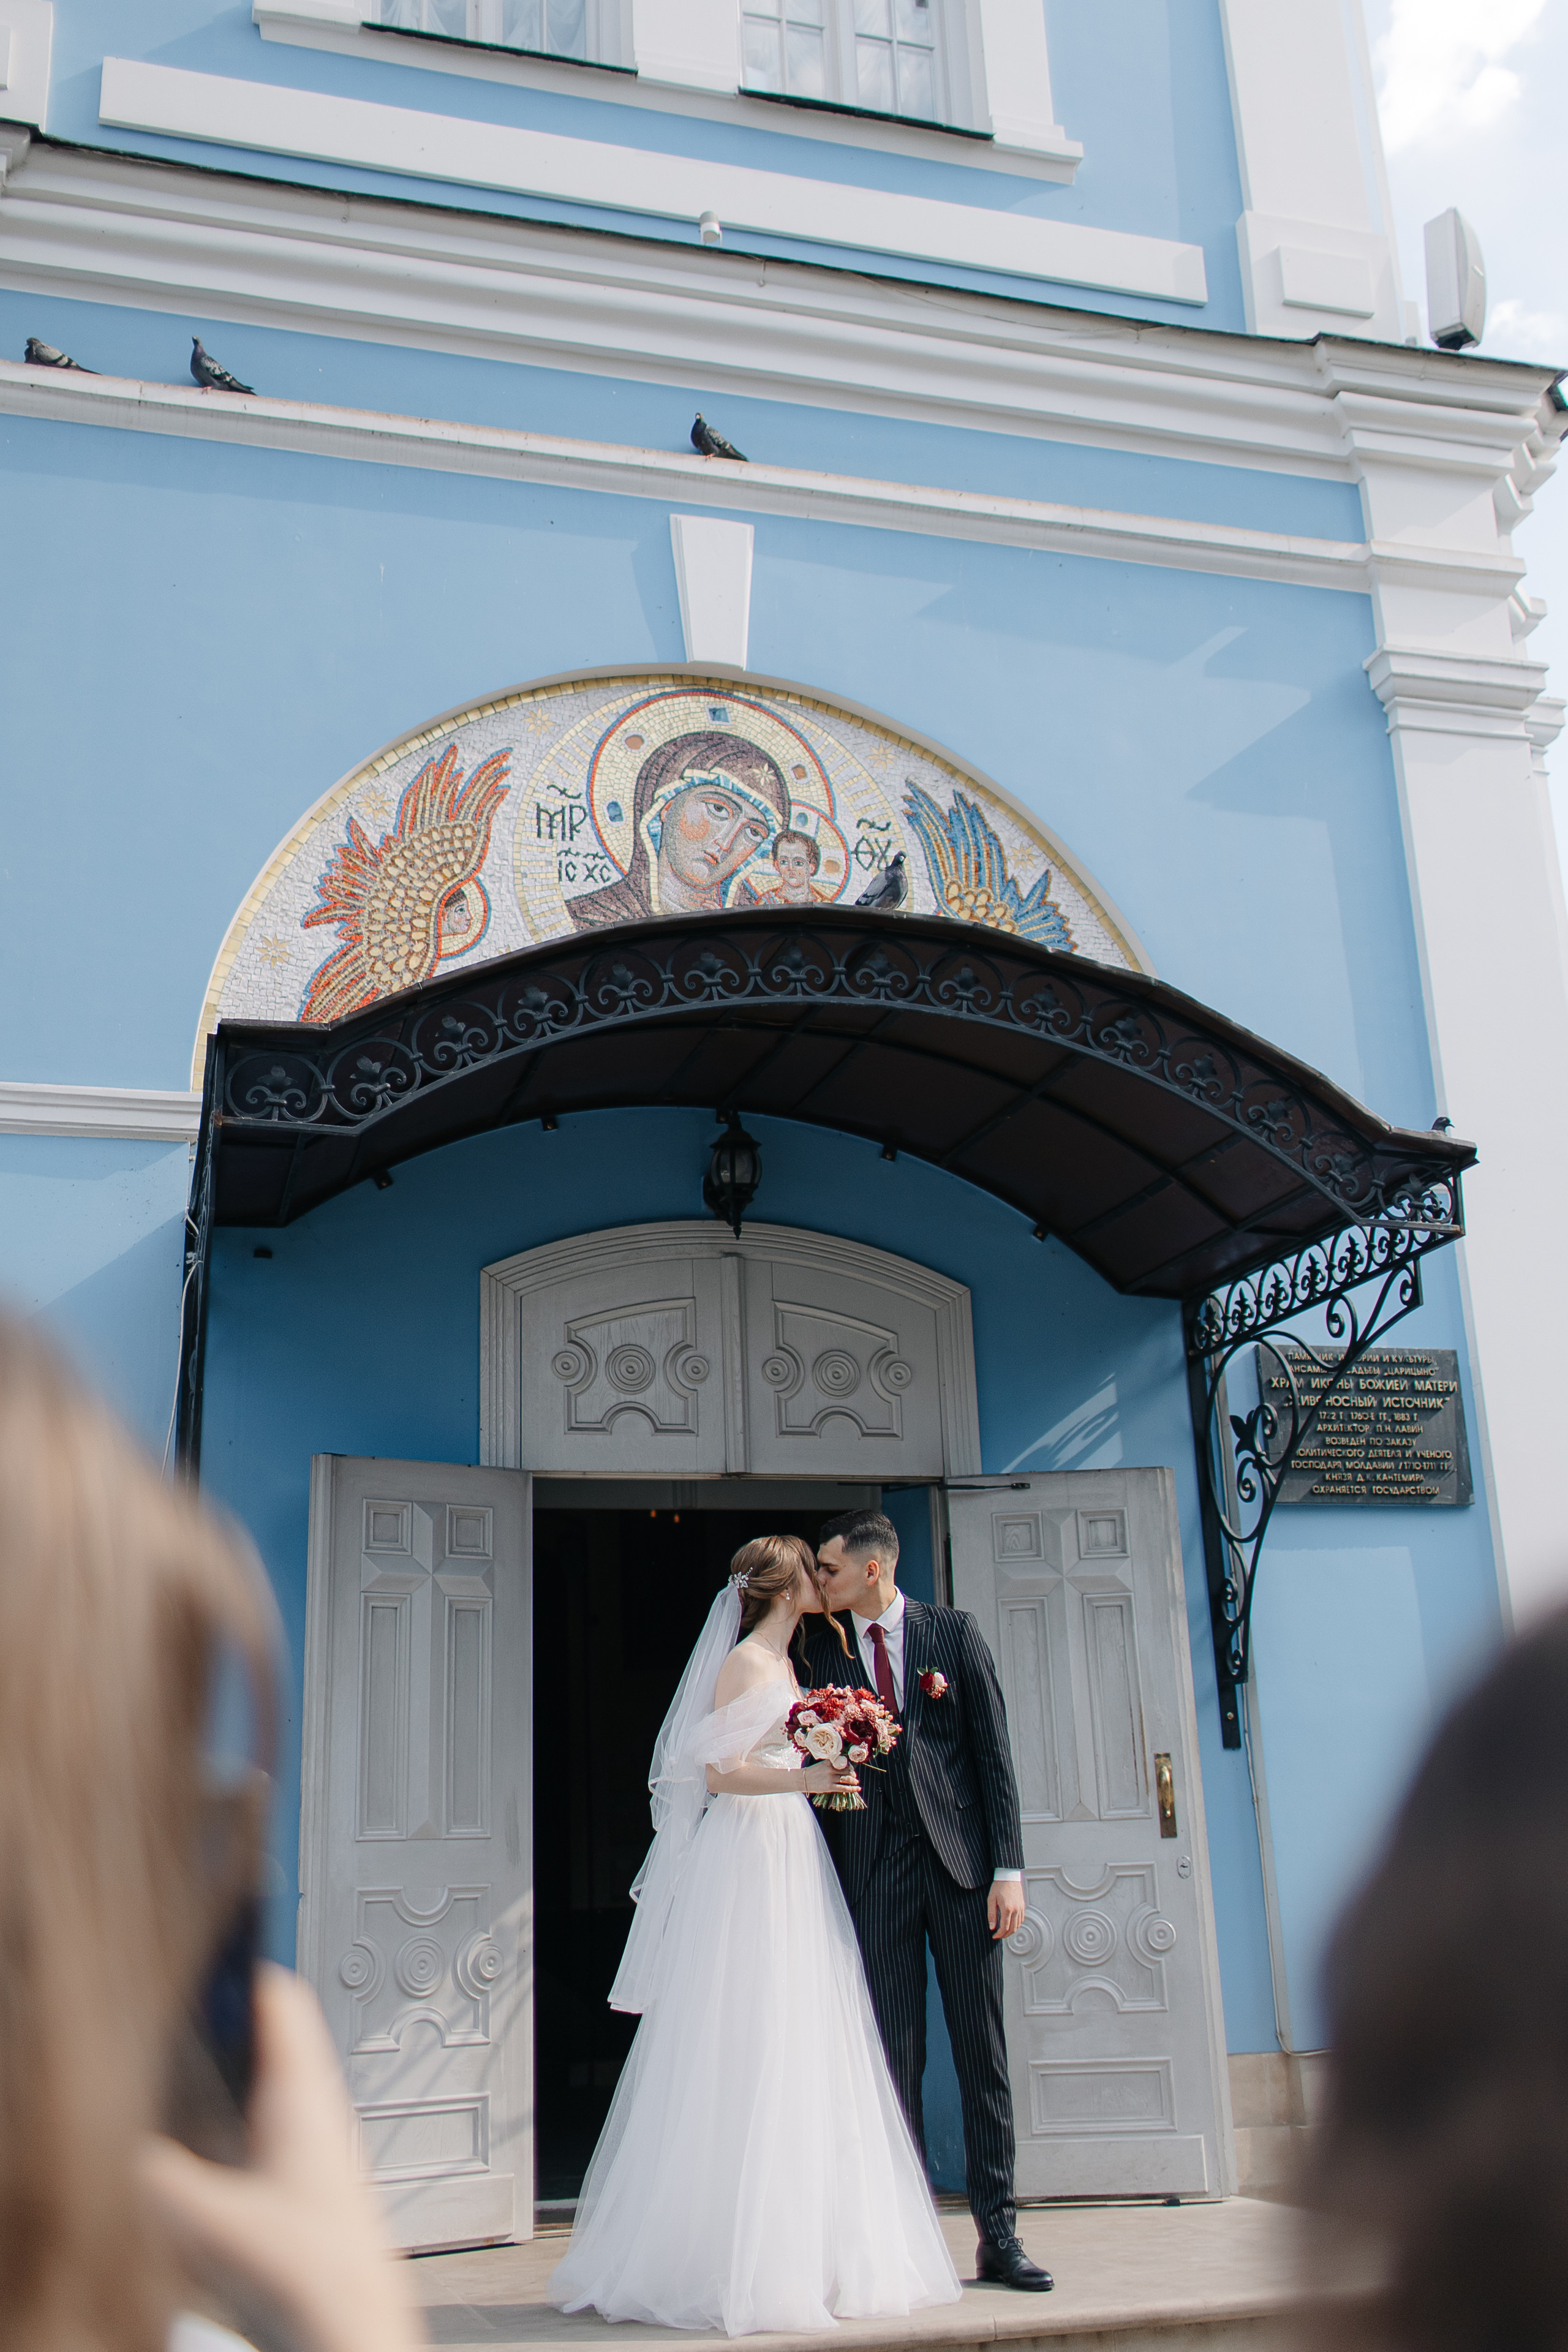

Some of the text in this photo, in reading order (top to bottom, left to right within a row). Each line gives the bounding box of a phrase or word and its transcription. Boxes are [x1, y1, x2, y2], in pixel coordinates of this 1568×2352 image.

[1414, 1379, 1458, 1392] МАТЕРИ
[1393, 1412, 1411, 1421] 1883
[1316, 1423, 1370, 1433] АРХИТЕКТОР
[1395, 1425, 1423, 1433] ЛАВИН
[1325, 1437, 1417, 1446] ВОЗВЕДЕН ПО ЗАКАЗУ
[1295, 1448, 1365, 1457] ОЛИТИЧЕСКОГО
[1368, 1449, 1402, 1458] ДЕЯТЕЛЯ
[1291, 1460, 1342, 1469] ГОСПОДАРЯ
[1346, 1461, 1395, 1470] МОЛДАВИИ
[1325, 1472, 1352, 1481] КНЯЗЯ
[1376, 1473, 1425, 1482] КАНТЕМИРА
[1312, 1485, 1439, 1495] ОХРАНЯЕТСЯ ГОСУДАРСТВОМ
